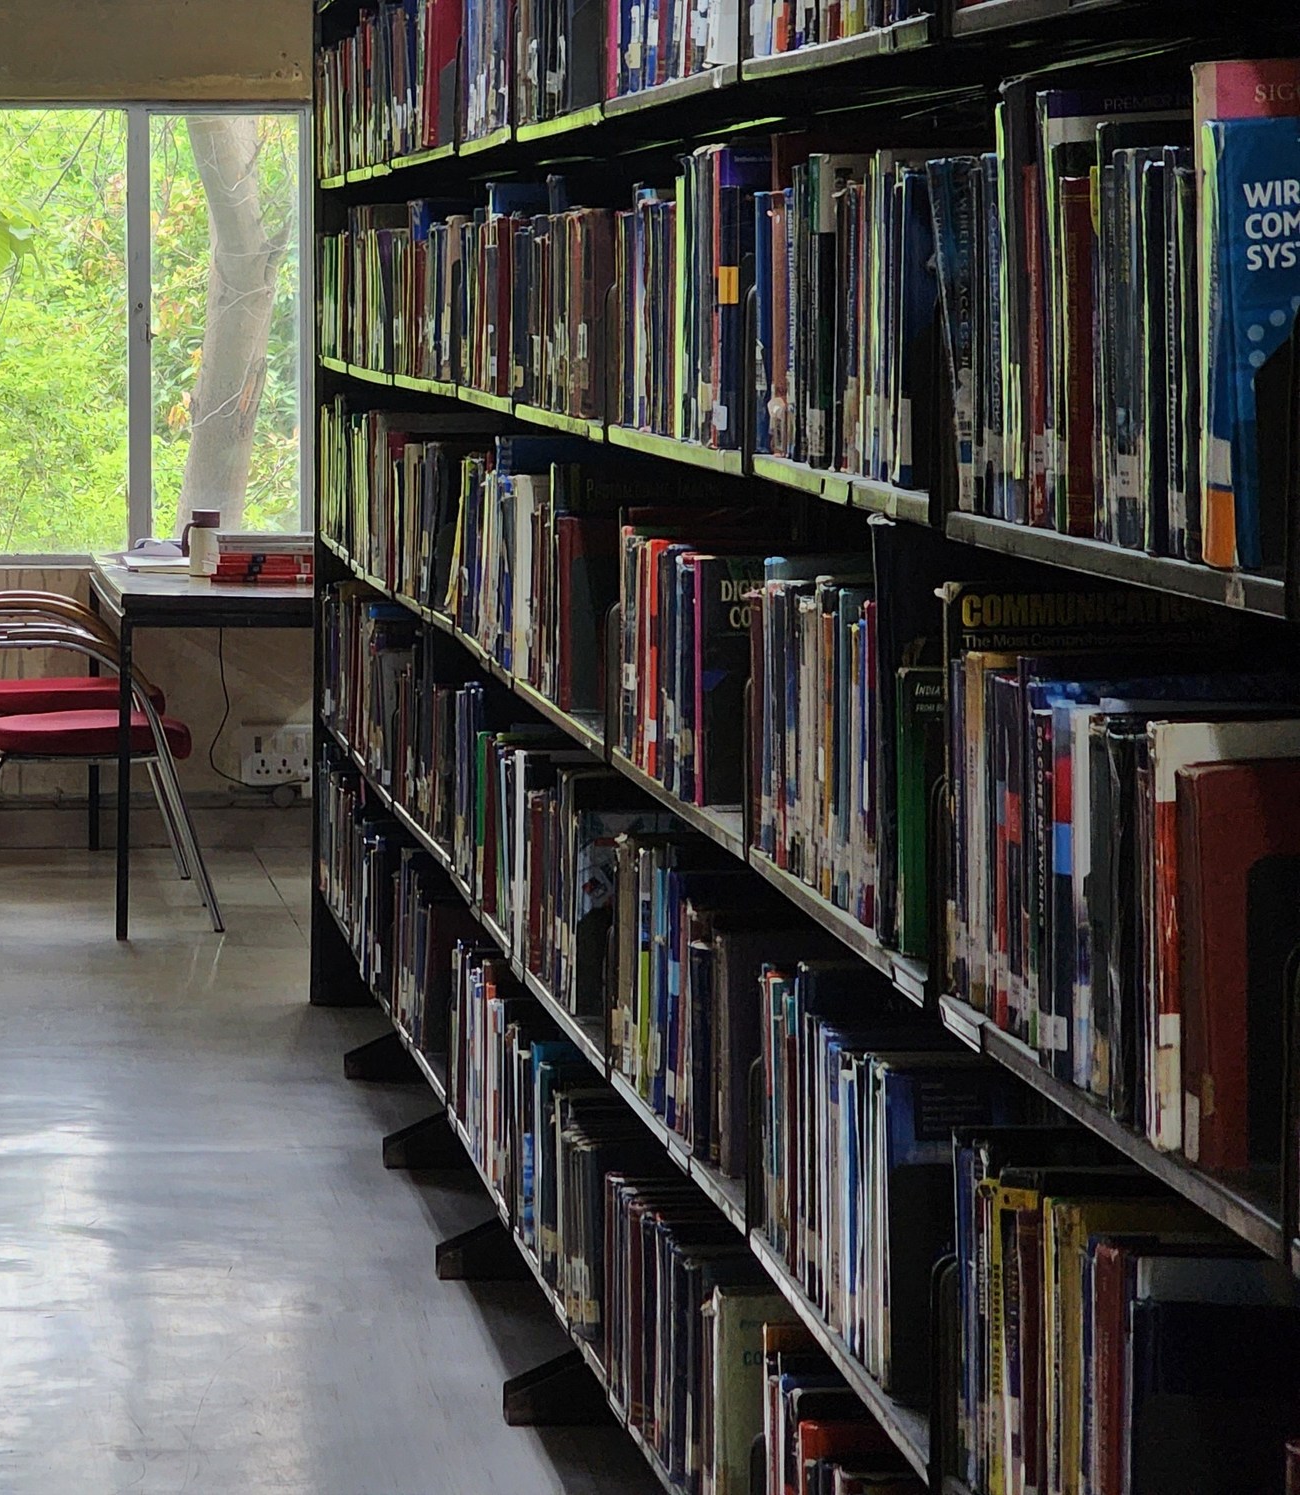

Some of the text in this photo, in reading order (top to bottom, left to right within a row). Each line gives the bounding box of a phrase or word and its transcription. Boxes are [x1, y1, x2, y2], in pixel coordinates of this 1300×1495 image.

[959, 197, 970, 278] WIRELESS
[989, 202, 998, 312] COGNITIVE
[1246, 241, 1300, 272] SYS
[959, 284, 970, 349] ACCESS
[1167, 241, 1176, 374] Information
[962, 633, 990, 648] The
[993, 633, 1029, 648] Most
[1037, 756, 1045, 809] CORE
[1037, 814, 1046, 927] NETWORKS
[993, 1264, 1001, 1395] BROADBAND ACCESS
